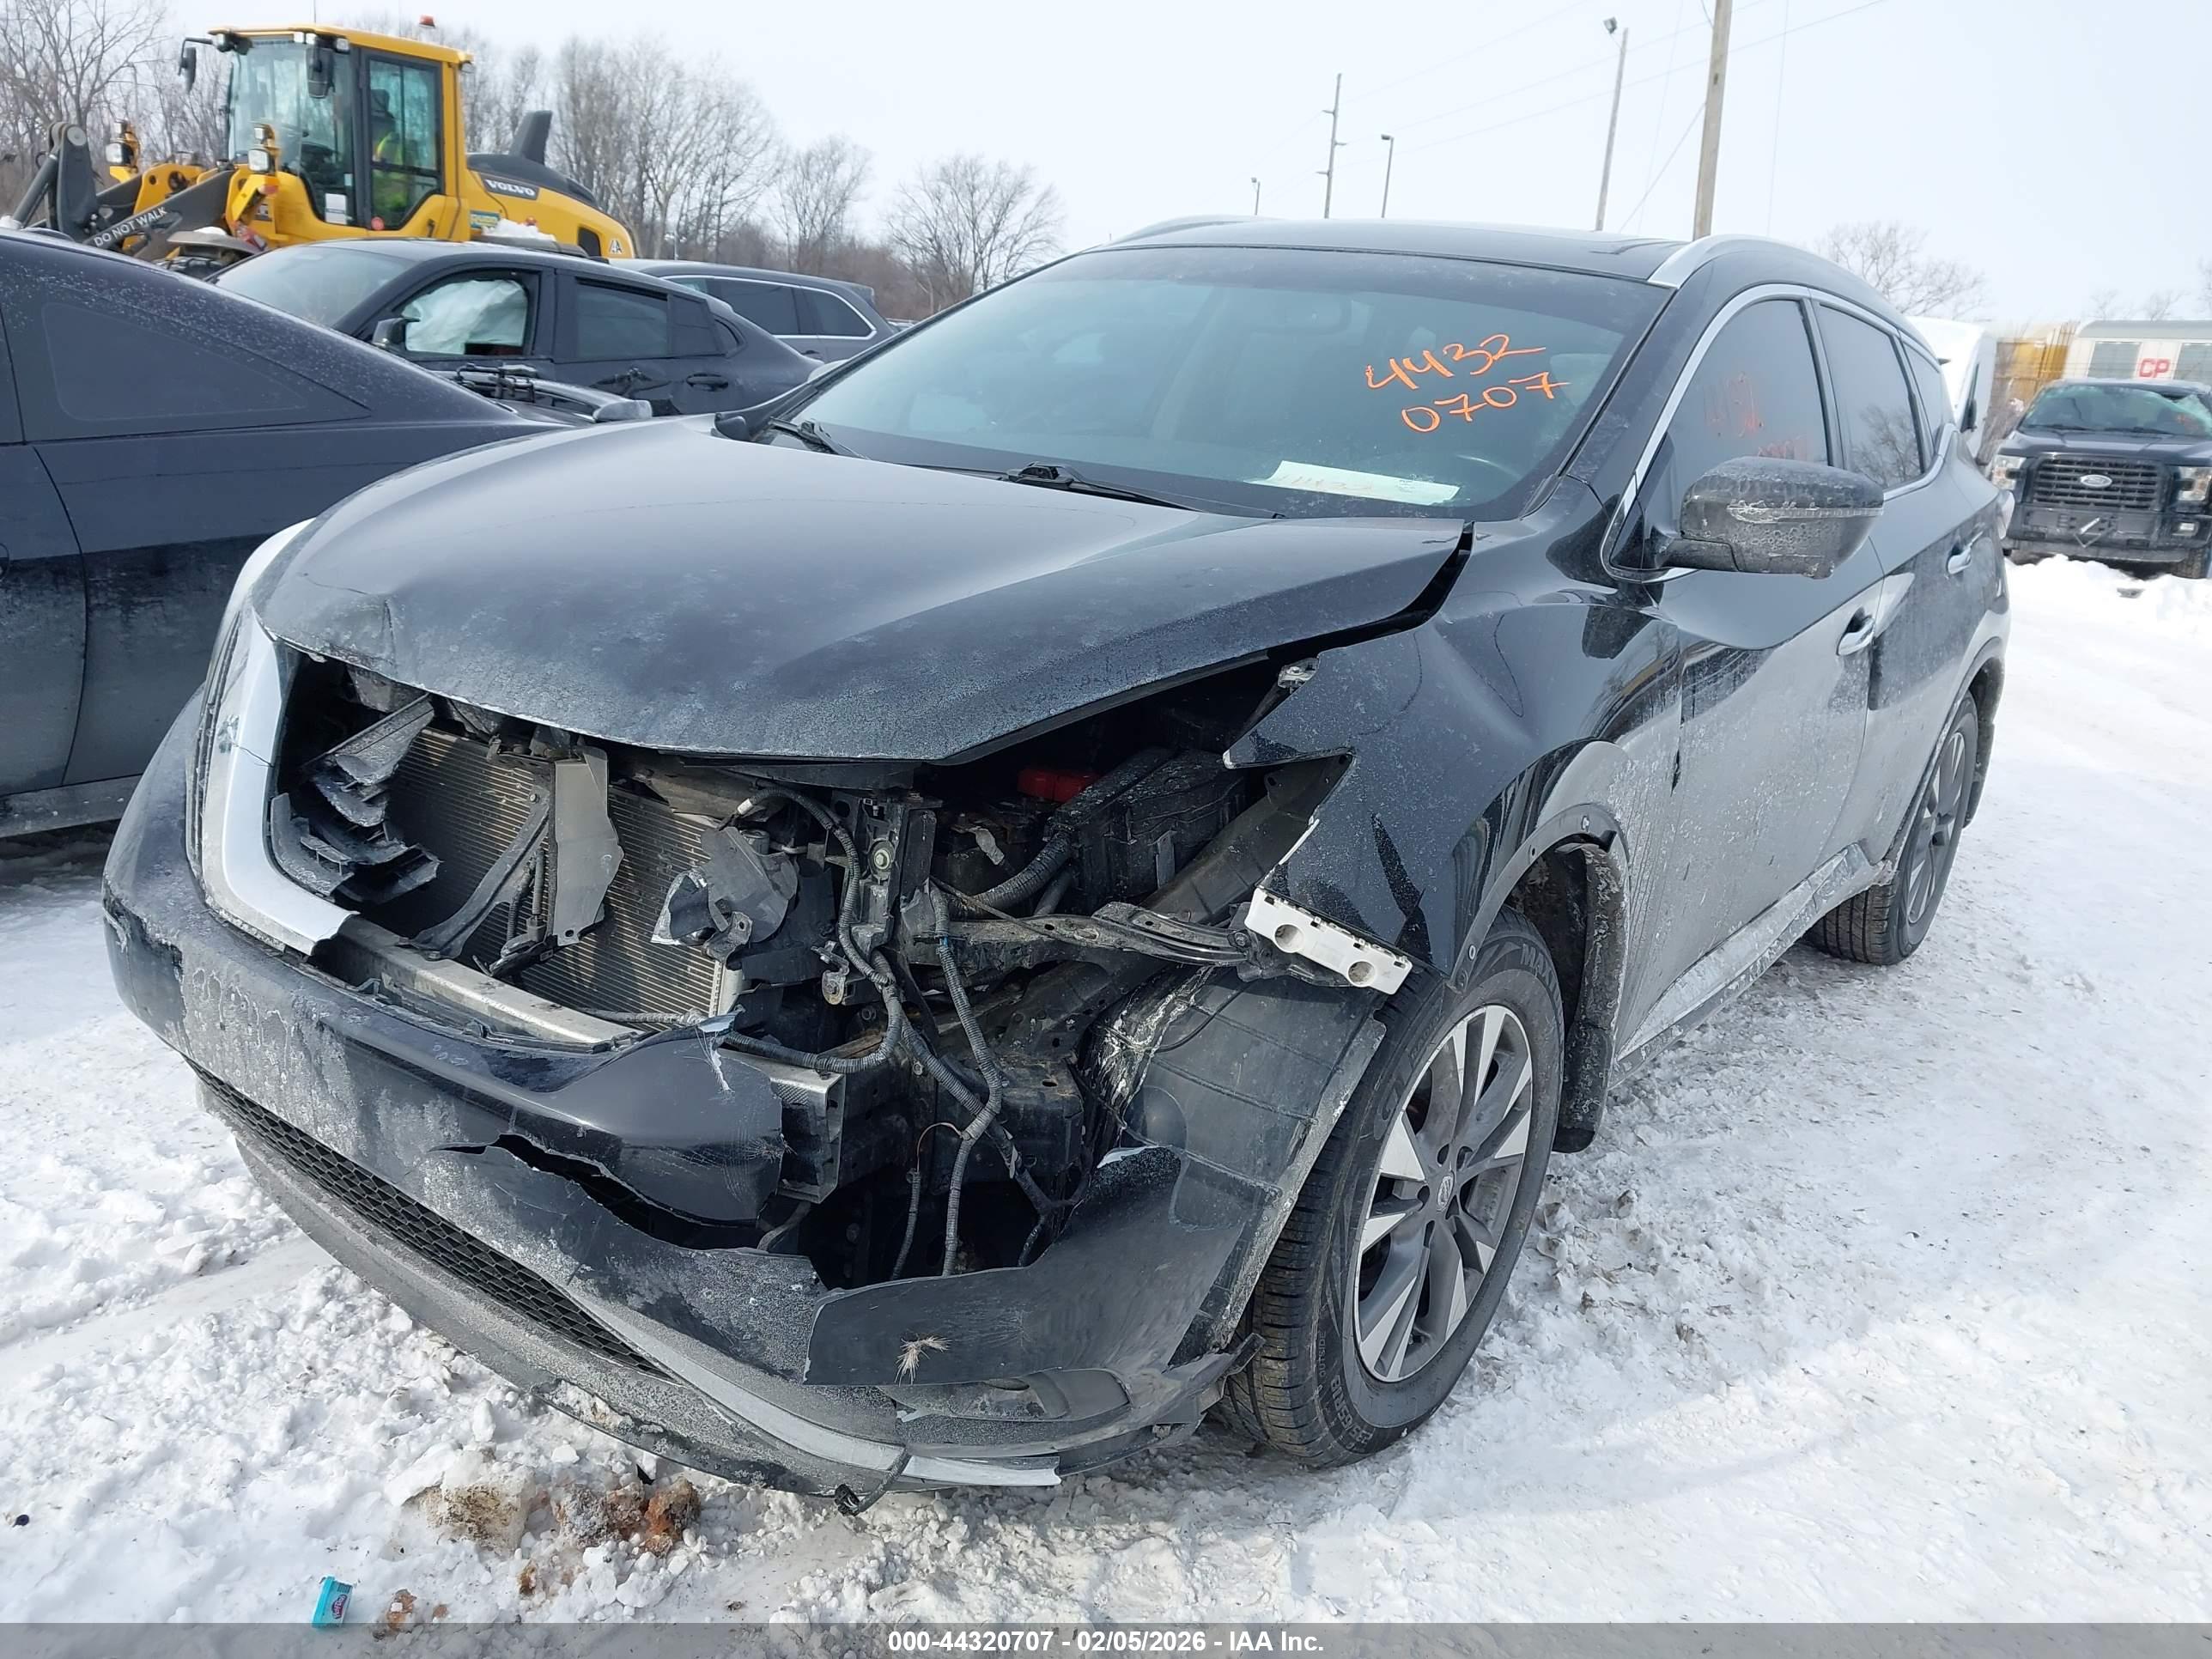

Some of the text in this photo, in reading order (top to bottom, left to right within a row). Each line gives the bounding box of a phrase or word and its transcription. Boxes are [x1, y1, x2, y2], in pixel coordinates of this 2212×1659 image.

[485, 179, 535, 196] VOLVO
[94, 206, 167, 247] DO NOT WALK
[1365, 333, 1547, 390] 4432
[2139, 357, 2170, 378] CP
[1401, 372, 1571, 432] 0707
